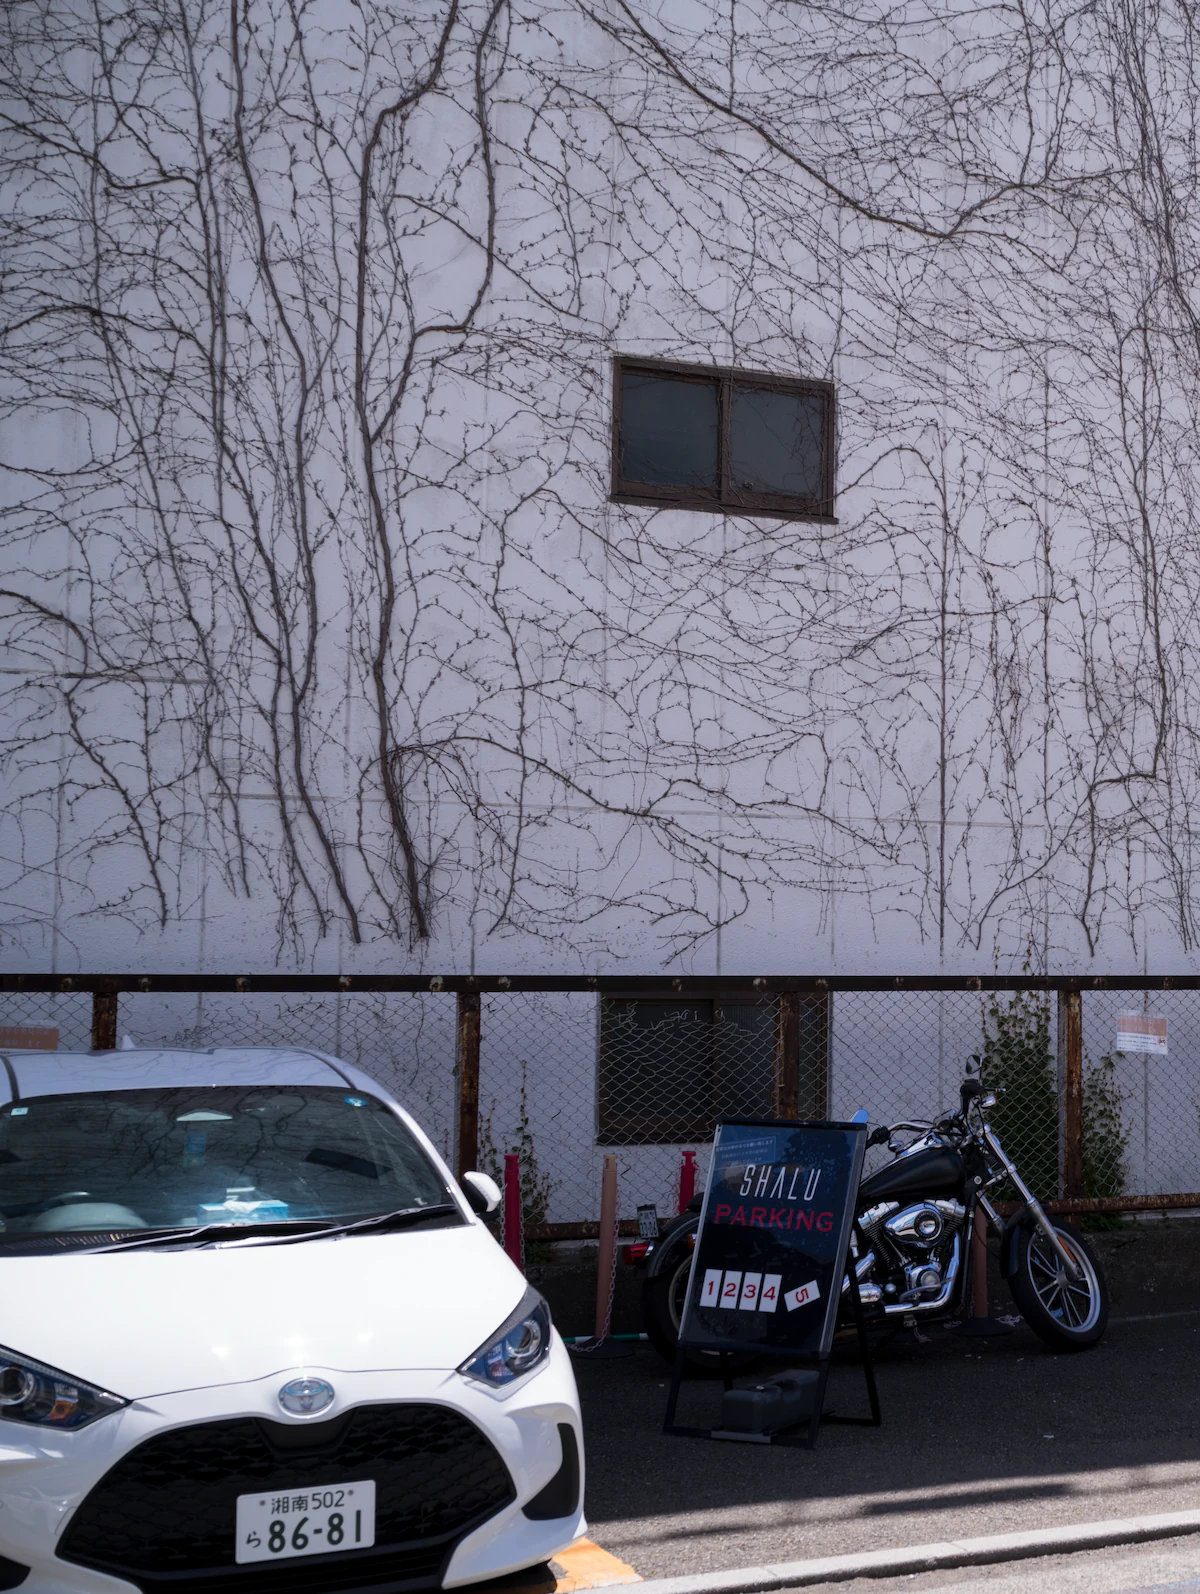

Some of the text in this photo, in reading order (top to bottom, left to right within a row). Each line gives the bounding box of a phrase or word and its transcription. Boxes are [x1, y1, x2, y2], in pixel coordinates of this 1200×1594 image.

[739, 1164, 821, 1201] SHALU
[714, 1204, 834, 1232] PARKING
[245, 1509, 362, 1553] ら 86-81
